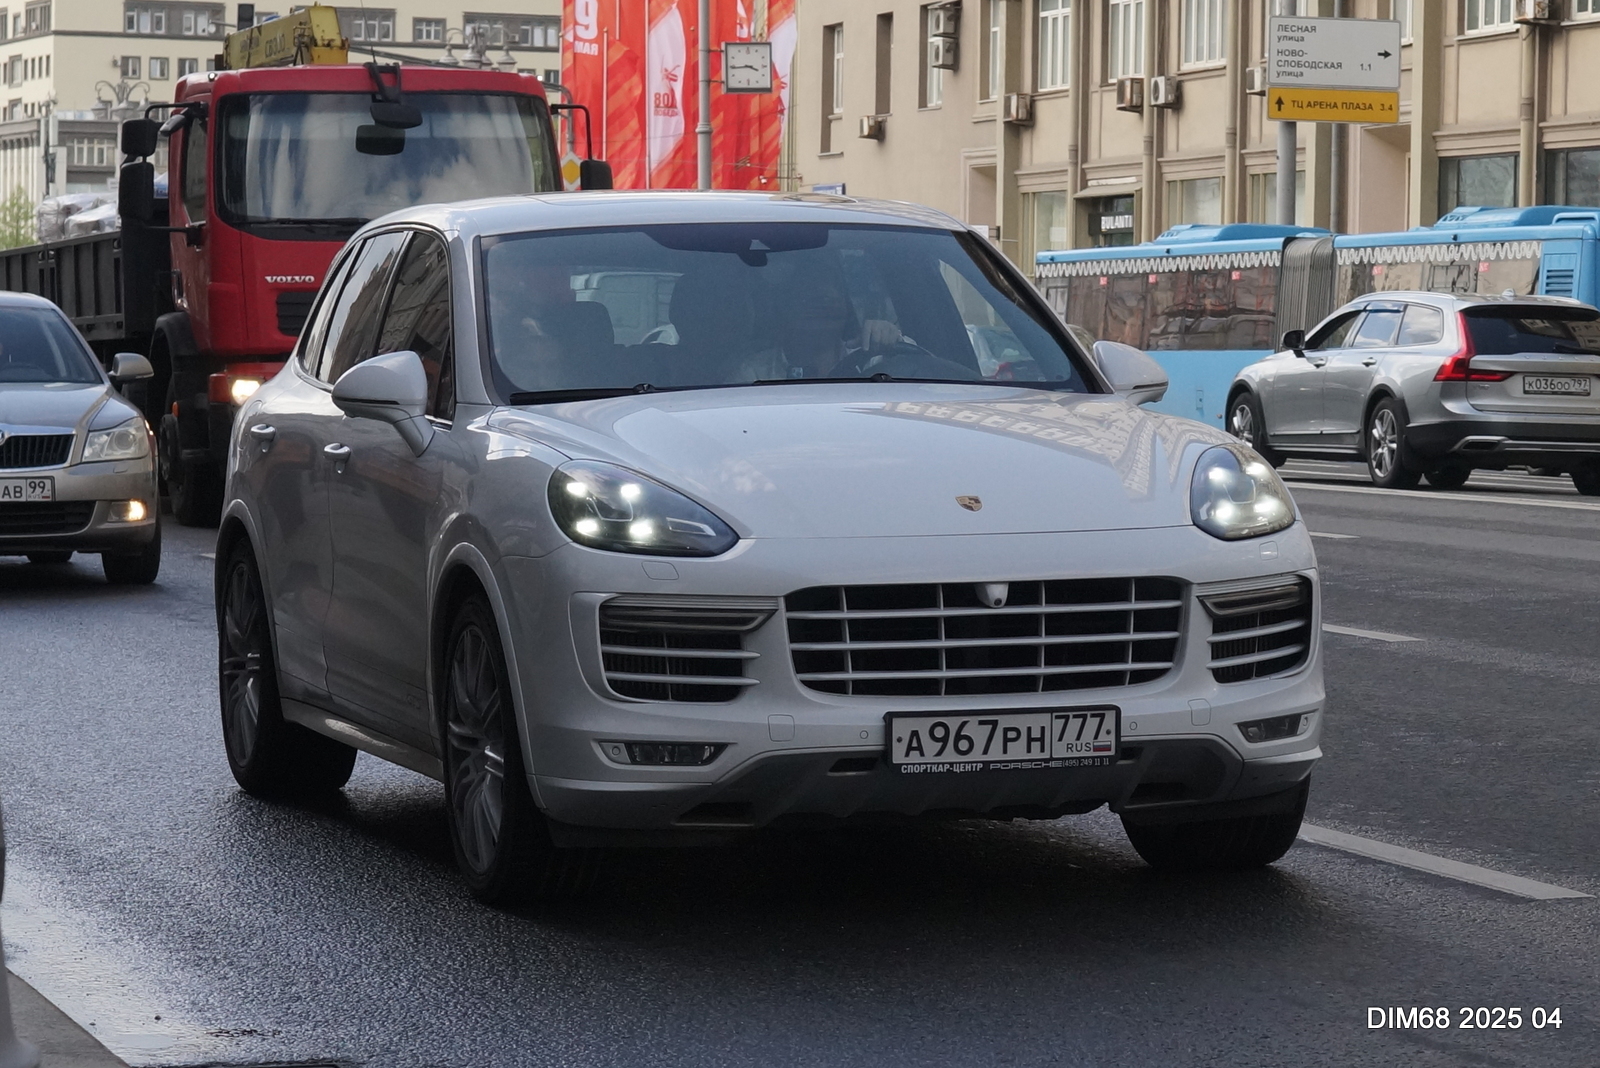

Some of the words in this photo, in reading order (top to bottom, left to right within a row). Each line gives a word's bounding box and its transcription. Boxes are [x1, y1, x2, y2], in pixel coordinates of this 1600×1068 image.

[1277, 24, 1317, 33] ЛЕСНАЯ
[1276, 35, 1305, 43] улица
[1276, 49, 1308, 58] НОВО-
[1276, 59, 1343, 70] СЛОБОДСКАЯ
[1360, 63, 1372, 71] 1.1
[1275, 70, 1304, 78] улица
[1291, 100, 1304, 109] ТЦ
[1306, 101, 1339, 110] АРЕНА
[1341, 101, 1374, 111] ПЛАЗА
[1379, 103, 1393, 111] 3.4
[264, 275, 315, 283] VOLVO
[28, 480, 46, 494] 99
[1054, 712, 1107, 743] 777
[1066, 742, 1092, 753] RUS
[901, 763, 983, 774] СПОРТКАР-ЦЕНТР
[990, 760, 1062, 770] PORSCHE
